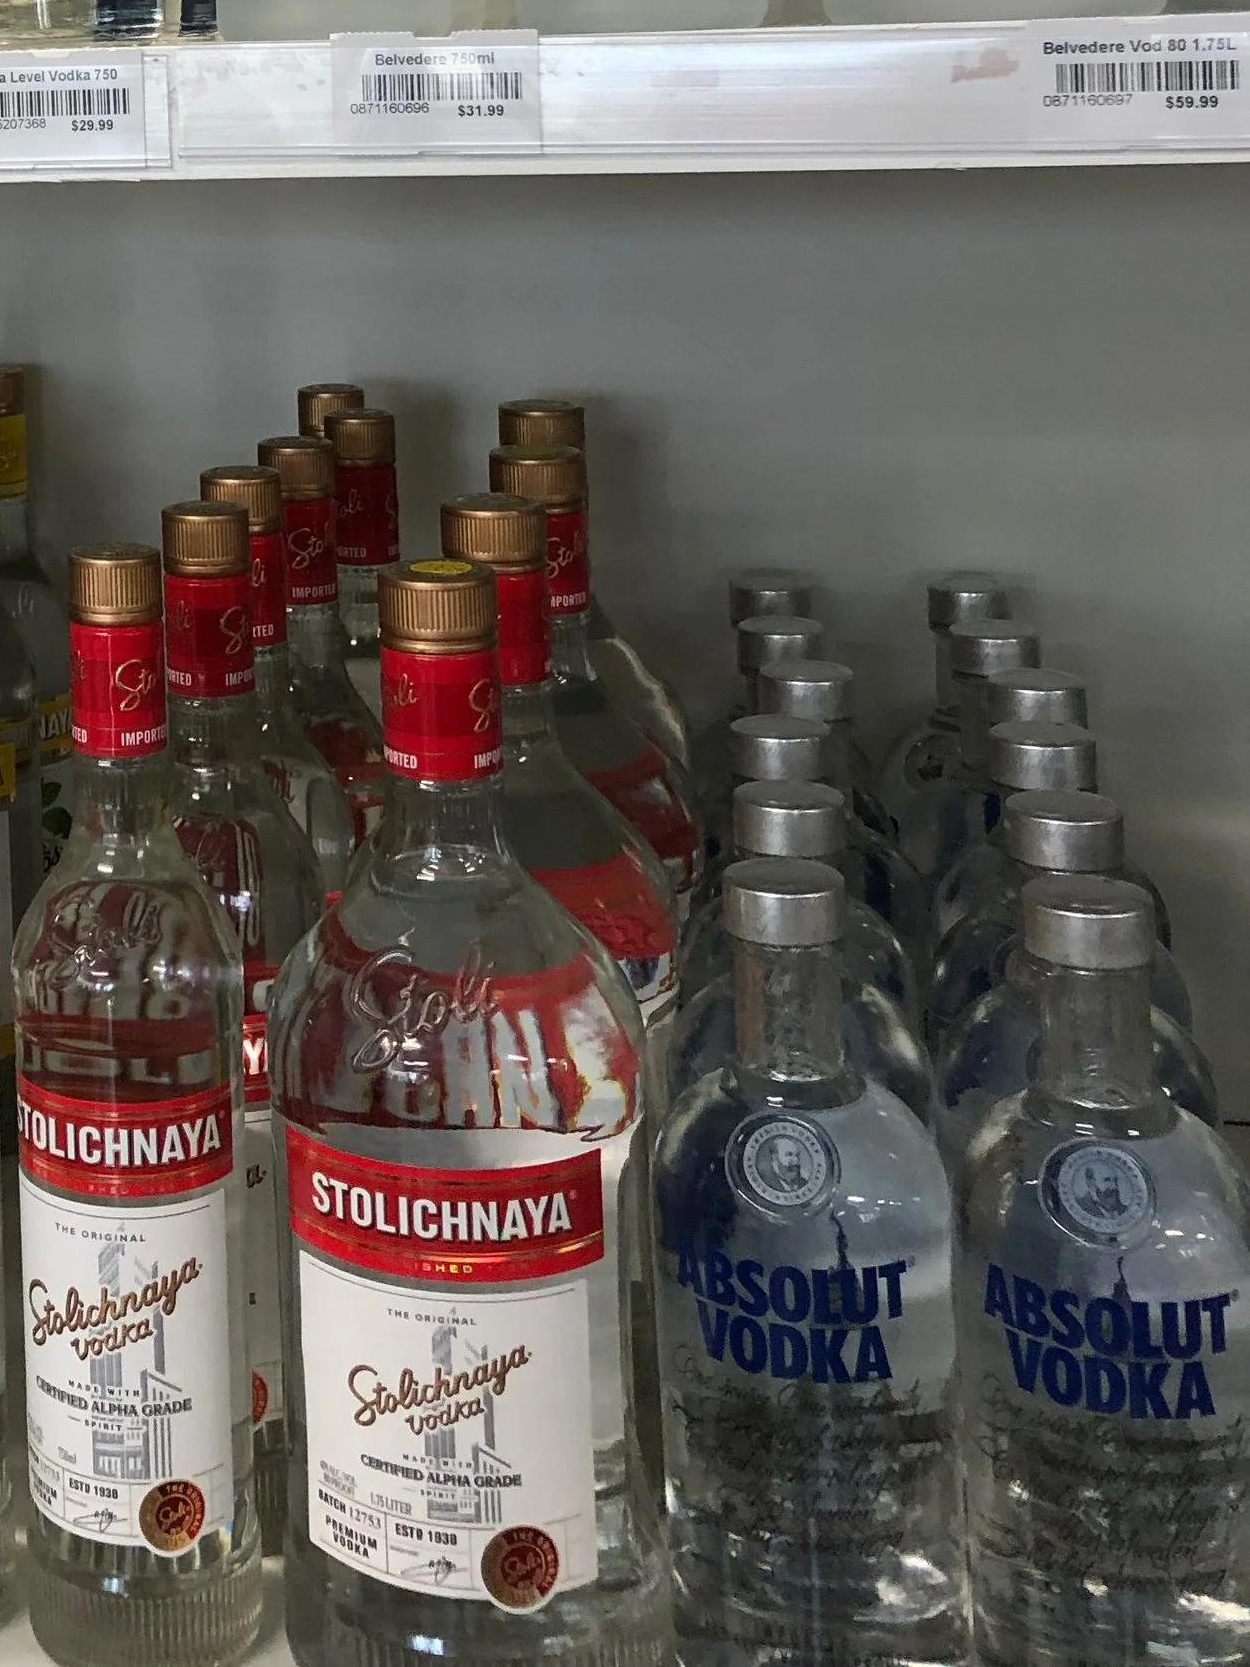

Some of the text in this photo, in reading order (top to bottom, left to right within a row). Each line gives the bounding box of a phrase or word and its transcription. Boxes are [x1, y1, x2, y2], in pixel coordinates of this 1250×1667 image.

[1043, 38, 1237, 55] Belvedere Vod 80 1.75L
[375, 52, 494, 66] Belvedere 750ml
[10, 71, 45, 83] Level
[49, 70, 91, 82] Vodka
[94, 69, 117, 81] 750
[351, 102, 504, 117] 0871160696 $31.99
[1166, 96, 1219, 109] $59.99
[71, 120, 114, 132] $29.99
[17, 1092, 222, 1168] STOLICHNAYA
[311, 1170, 573, 1243] STOLICHNAYA
[55, 1222, 147, 1244] THE ORIGINAL
[677, 1244, 908, 1326] ABSOLUT
[28, 1256, 199, 1346] Stolichnaya
[984, 1261, 1232, 1359] ABSOLUT
[386, 1308, 477, 1327] THE ORIGINAL
[70, 1318, 154, 1362] vodka
[695, 1299, 894, 1385] VODKA
[68, 1379, 140, 1397] MADE WITH
[347, 1342, 531, 1428] Stolichnaya
[1003, 1331, 1217, 1422] VODKA
[36, 1375, 192, 1417] CERTIFIED ALPHA GRADE
[85, 1419, 122, 1432] SPIRIT
[403, 1397, 484, 1437] vodka
[361, 1453, 424, 1481] CERTIFIED
[426, 1473, 471, 1488] ALPHA
[474, 1474, 523, 1488] GRADE
[443, 1461, 472, 1469] WITH
[69, 1478, 90, 1494] ESTD
[420, 1489, 456, 1500] SPIRIT
[318, 1488, 346, 1515] BATCH
[385, 1496, 412, 1516] LITER
[325, 1514, 378, 1550] PREMIUM
[395, 1523, 423, 1542] ESTD
[332, 1533, 369, 1559] VODKA
